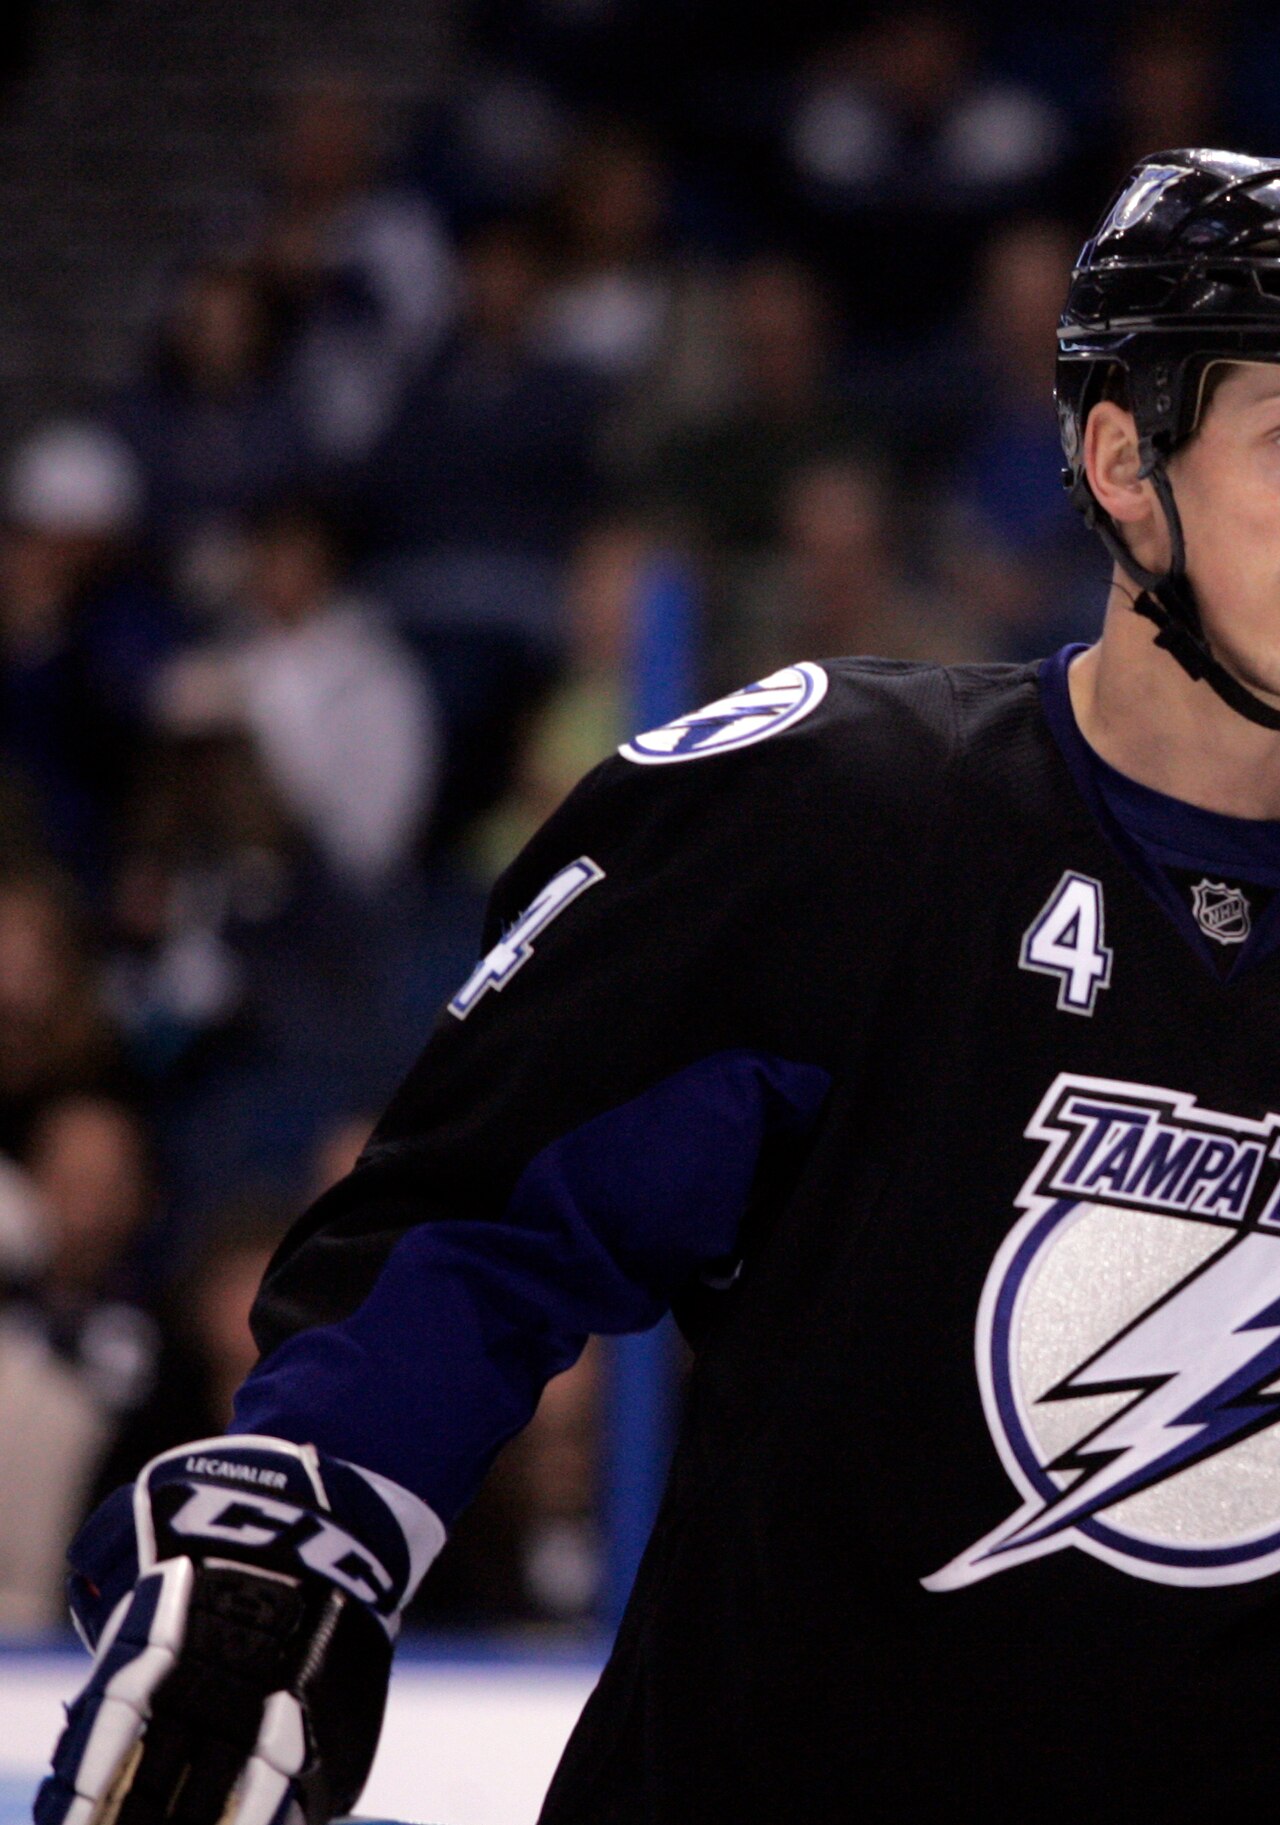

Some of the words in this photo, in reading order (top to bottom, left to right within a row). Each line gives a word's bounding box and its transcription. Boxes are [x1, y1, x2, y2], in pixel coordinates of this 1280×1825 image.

[1018, 870, 1113, 1018] 4
[1208, 900, 1242, 926] NHL
[1050, 1096, 1267, 1221] TAMPA
[186, 1456, 289, 1491] LECAVALIER
